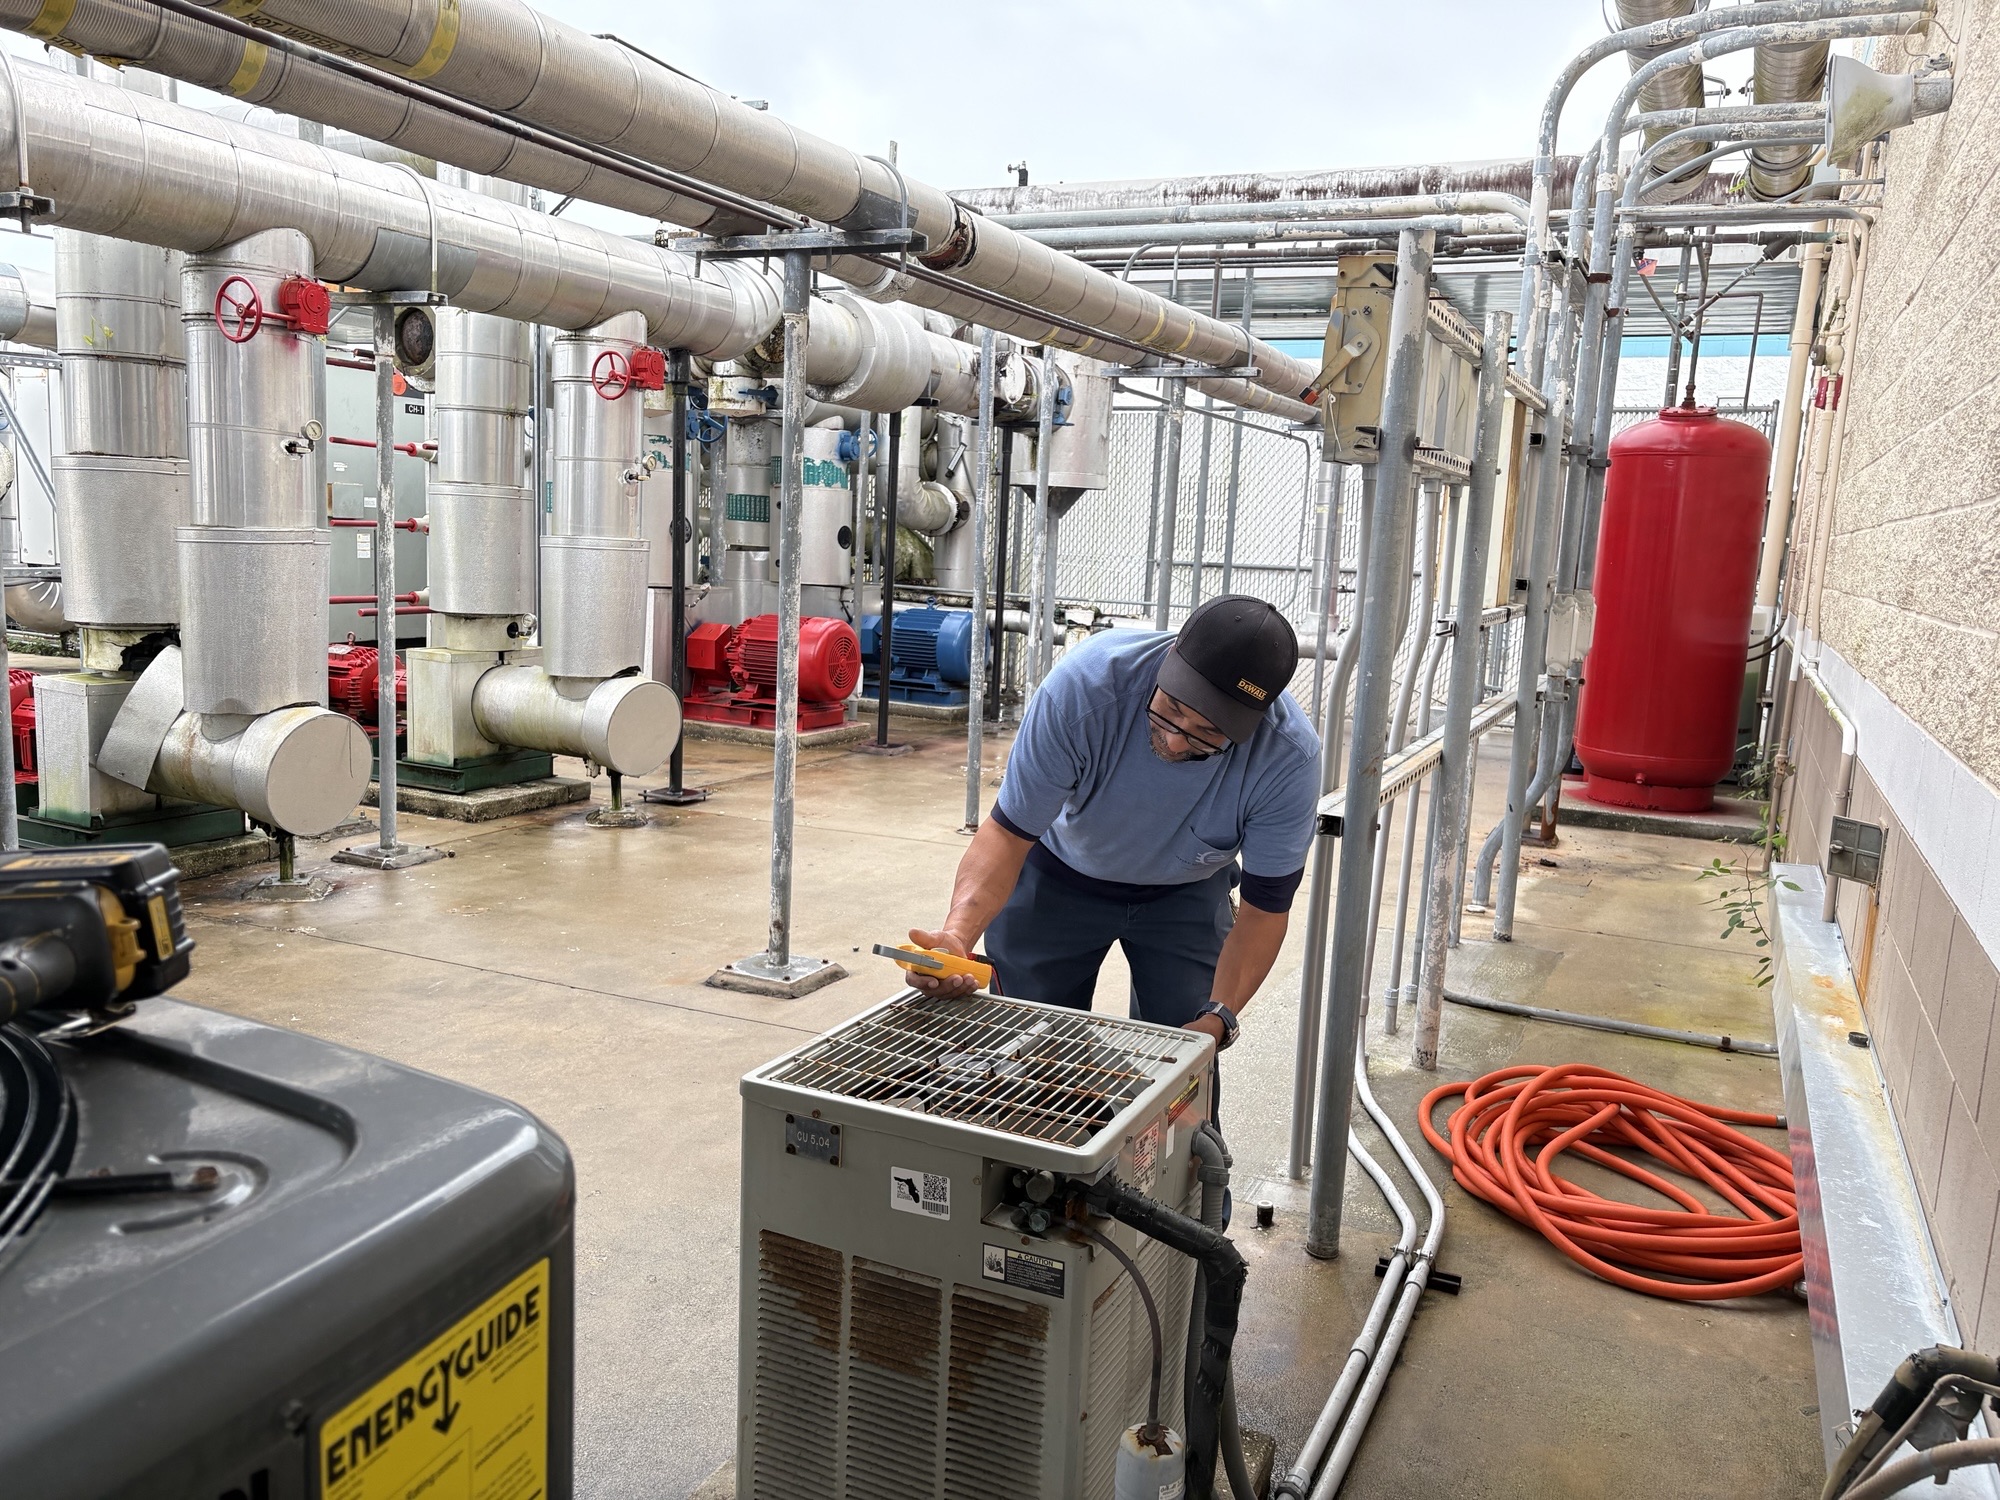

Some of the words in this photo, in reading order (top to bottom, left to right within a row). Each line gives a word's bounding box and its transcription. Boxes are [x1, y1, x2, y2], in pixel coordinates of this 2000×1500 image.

[240, 13, 284, 29] HOT
[281, 27, 340, 51] WATER
[408, 405, 424, 414] CH-1
[796, 1130, 808, 1143] CU
[810, 1135, 830, 1149] 5.04
[1024, 1254, 1054, 1267] CAUTION
[326, 1285, 541, 1486] ENERGYGUIDE
